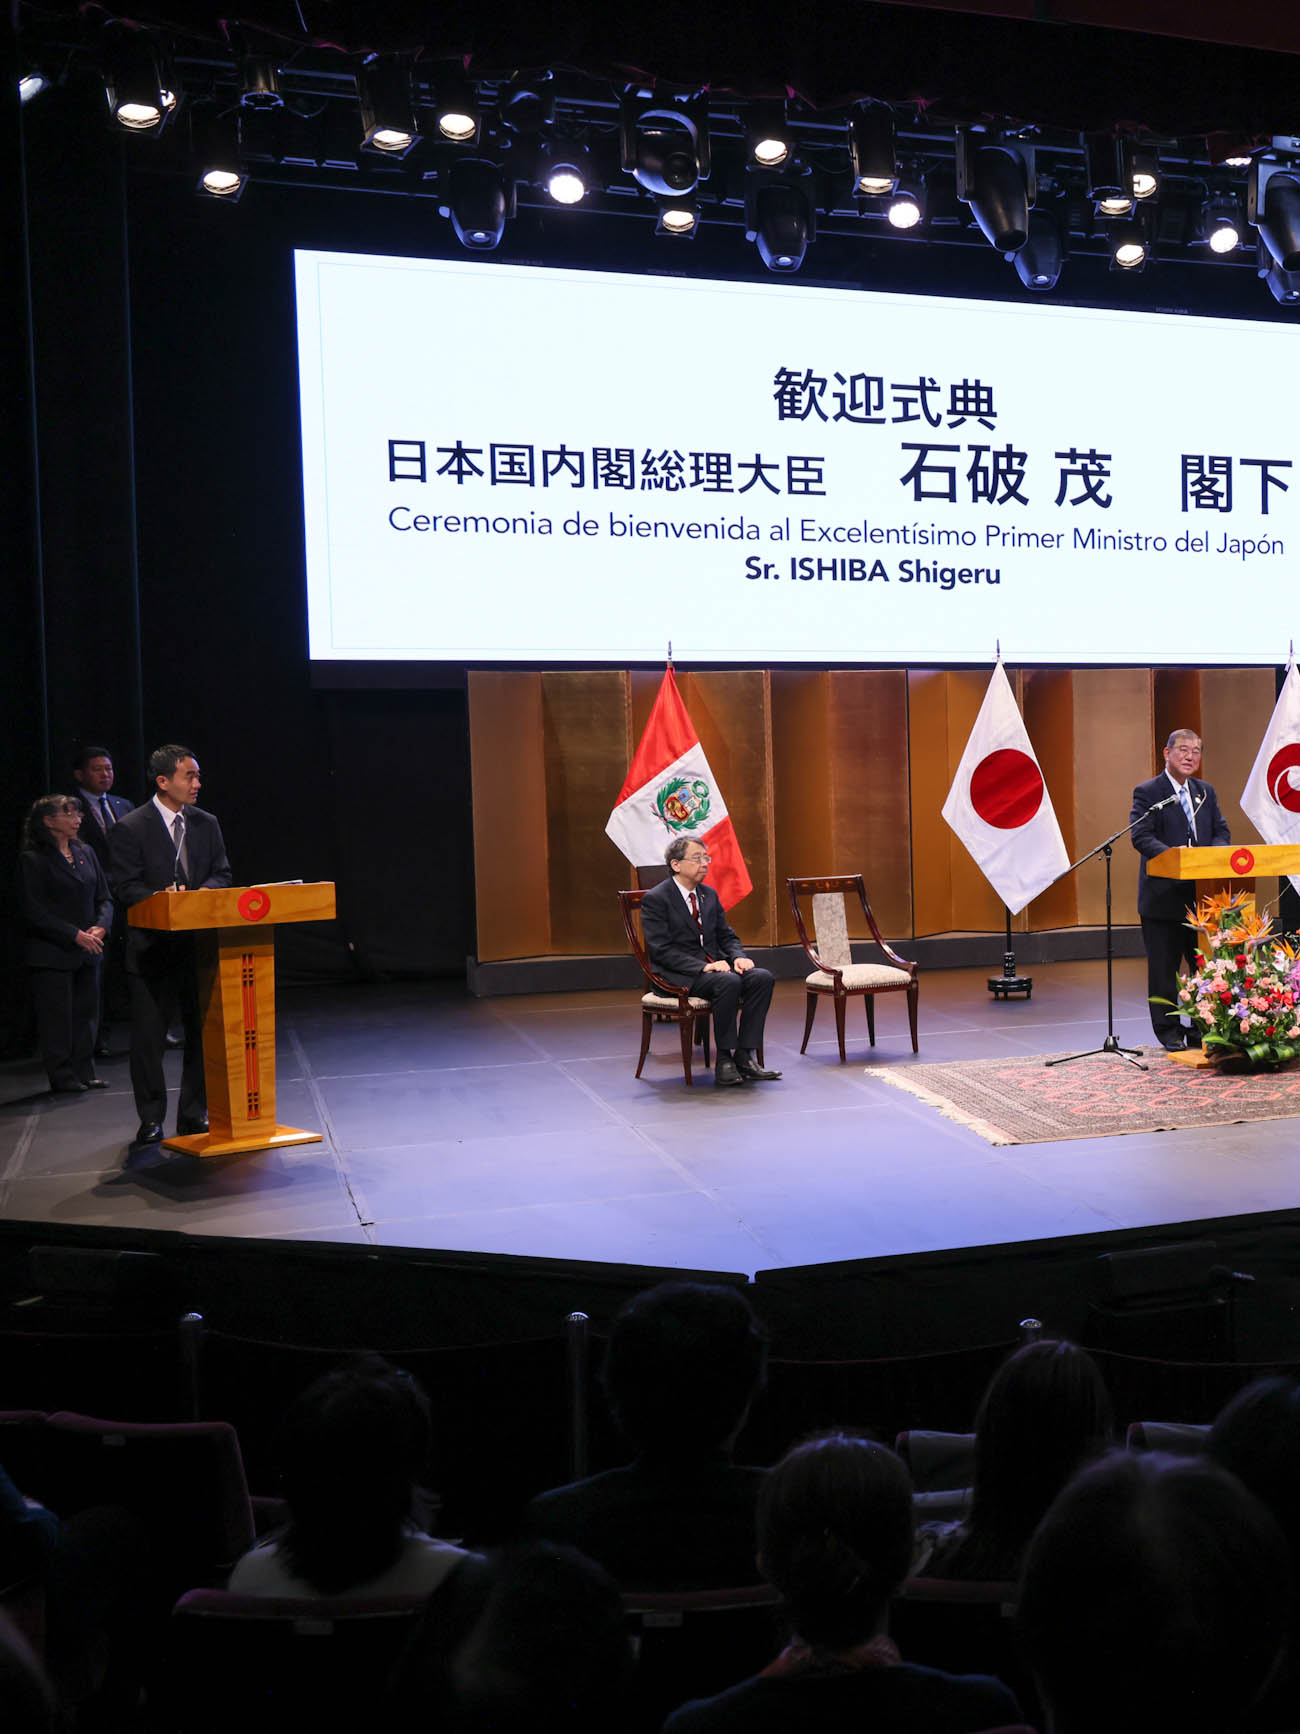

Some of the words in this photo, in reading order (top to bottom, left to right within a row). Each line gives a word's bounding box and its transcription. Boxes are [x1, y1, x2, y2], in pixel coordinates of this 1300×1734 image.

[773, 367, 997, 431] 歓迎式典
[388, 440, 826, 496] 日本国内閣総理大臣
[900, 442, 1029, 506] 石破
[1055, 448, 1112, 508] 茂
[1181, 454, 1292, 514] 閣下
[388, 506, 553, 535] Ceremonia
[563, 511, 600, 536] de
[609, 512, 760, 541] bienvenida
[769, 517, 790, 541] al
[801, 519, 977, 547] Excelentísimo
[986, 525, 1065, 549] Primer
[1073, 528, 1168, 552] Ministro
[1175, 530, 1209, 553] del
[1217, 533, 1284, 561] Japón
[745, 555, 780, 580] Sr.
[790, 557, 890, 582] ISHIBA
[898, 559, 1001, 590] Shigeru
